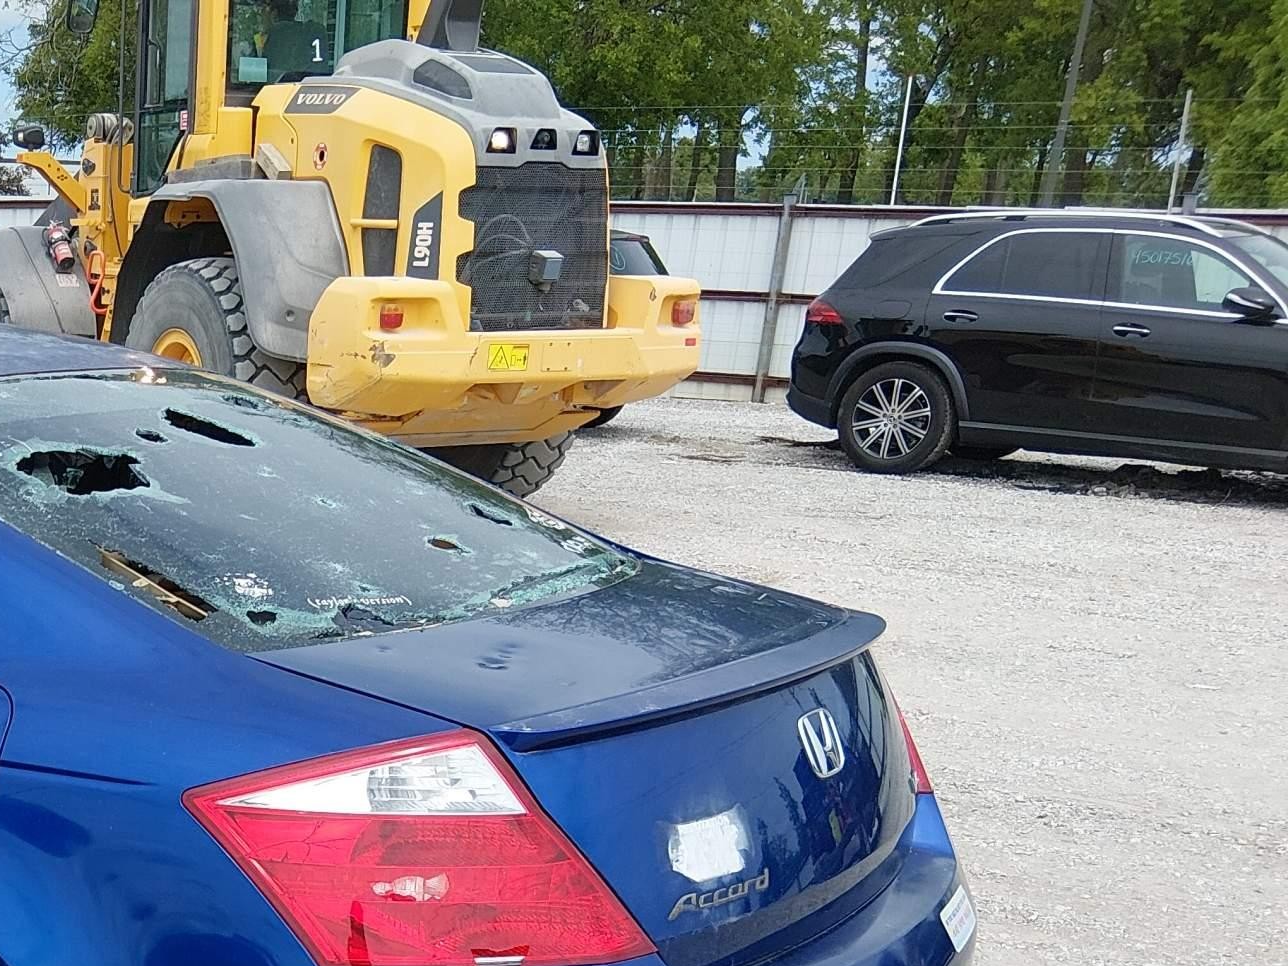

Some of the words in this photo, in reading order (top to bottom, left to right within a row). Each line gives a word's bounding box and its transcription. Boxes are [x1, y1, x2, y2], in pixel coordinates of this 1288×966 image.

[296, 93, 347, 105] VOLVO
[412, 221, 434, 267] L90H
[359, 595, 413, 606] version)
[668, 867, 770, 921] Accord
